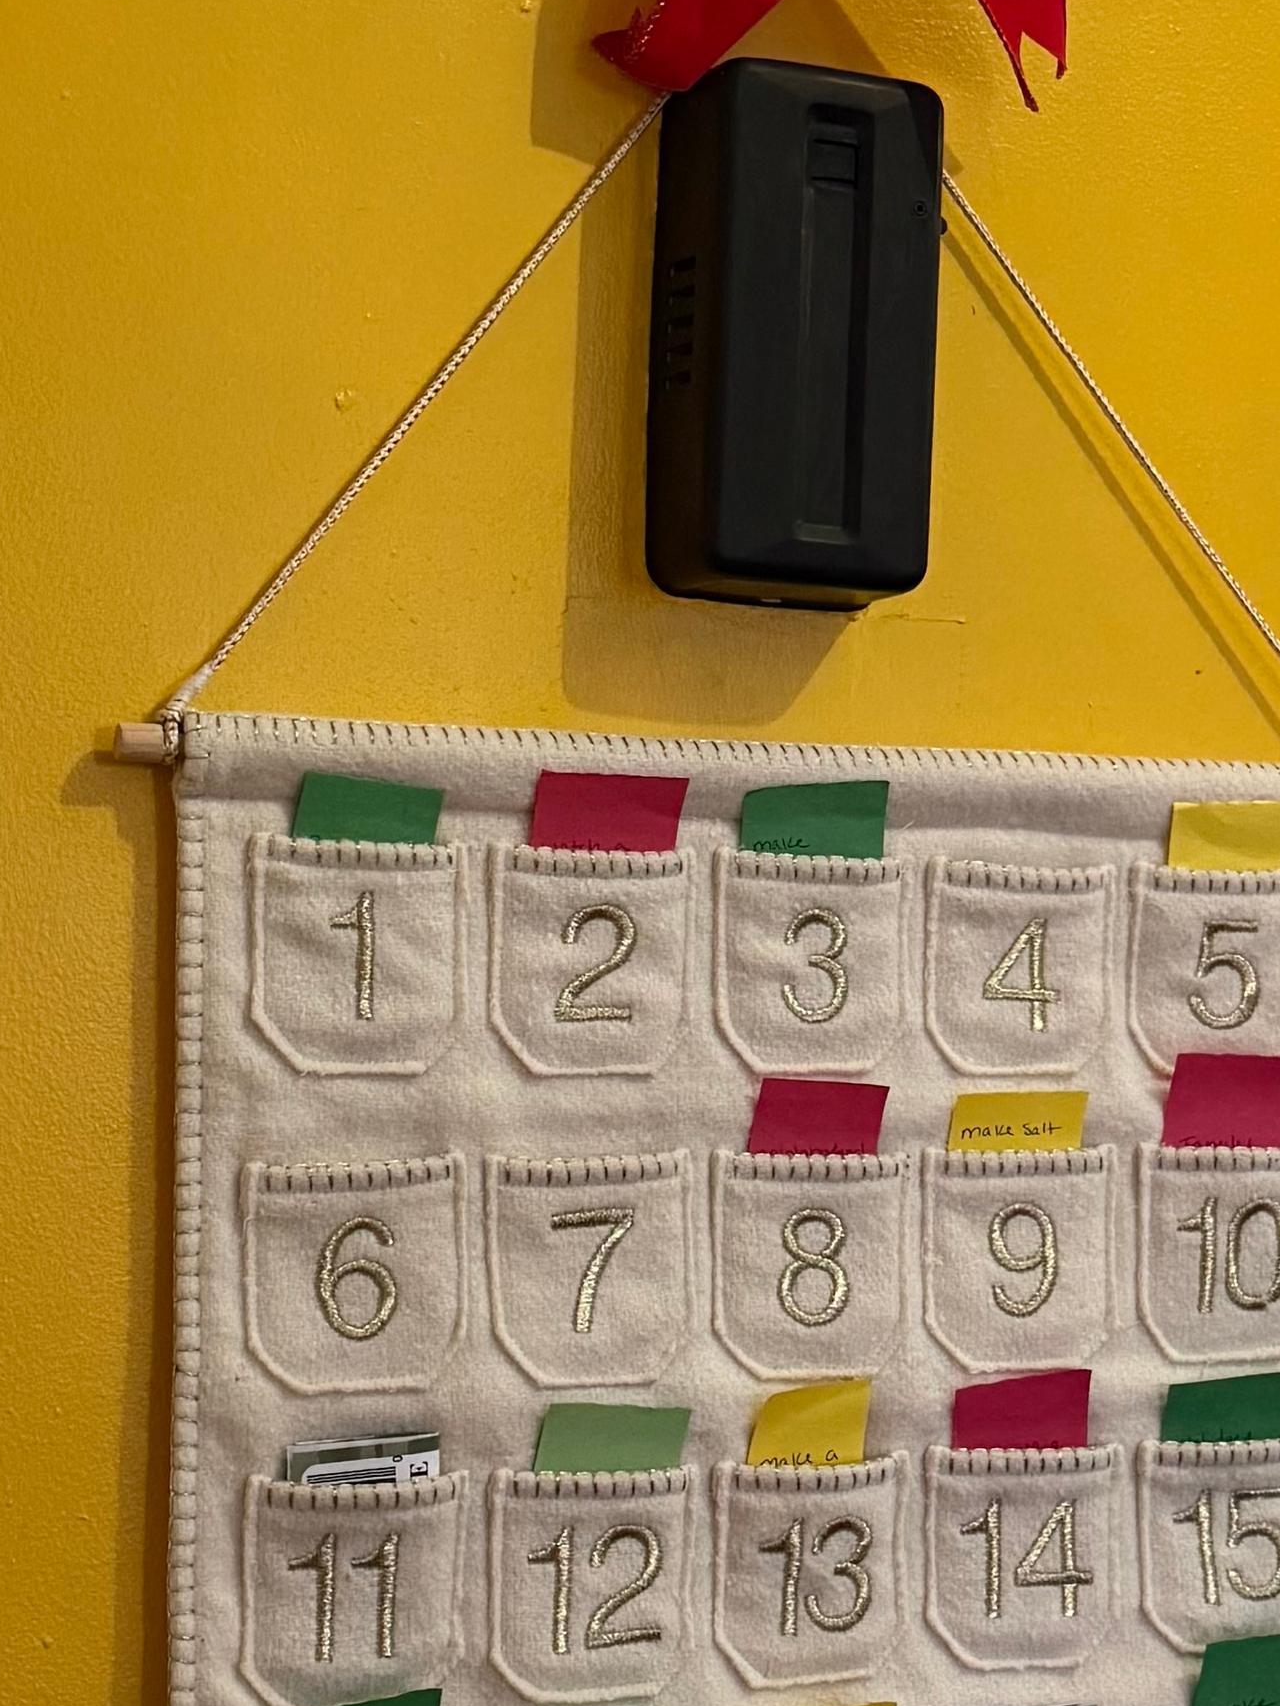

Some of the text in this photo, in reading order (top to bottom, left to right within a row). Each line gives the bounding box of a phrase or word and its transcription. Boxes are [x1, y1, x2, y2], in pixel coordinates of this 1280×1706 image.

[753, 836, 810, 852] make
[330, 890, 1260, 1033] 1 2 3 4 5
[961, 1124, 1014, 1139] make
[315, 1214, 398, 1340] 6
[551, 1206, 634, 1333] 7
[778, 1206, 851, 1327] 8
[989, 1201, 1059, 1317] 9
[760, 1449, 838, 1468] make a
[287, 1532, 401, 1664] 11
[527, 1524, 664, 1656] 12
[758, 1513, 873, 1636] 13
[959, 1496, 1094, 1620] 14
